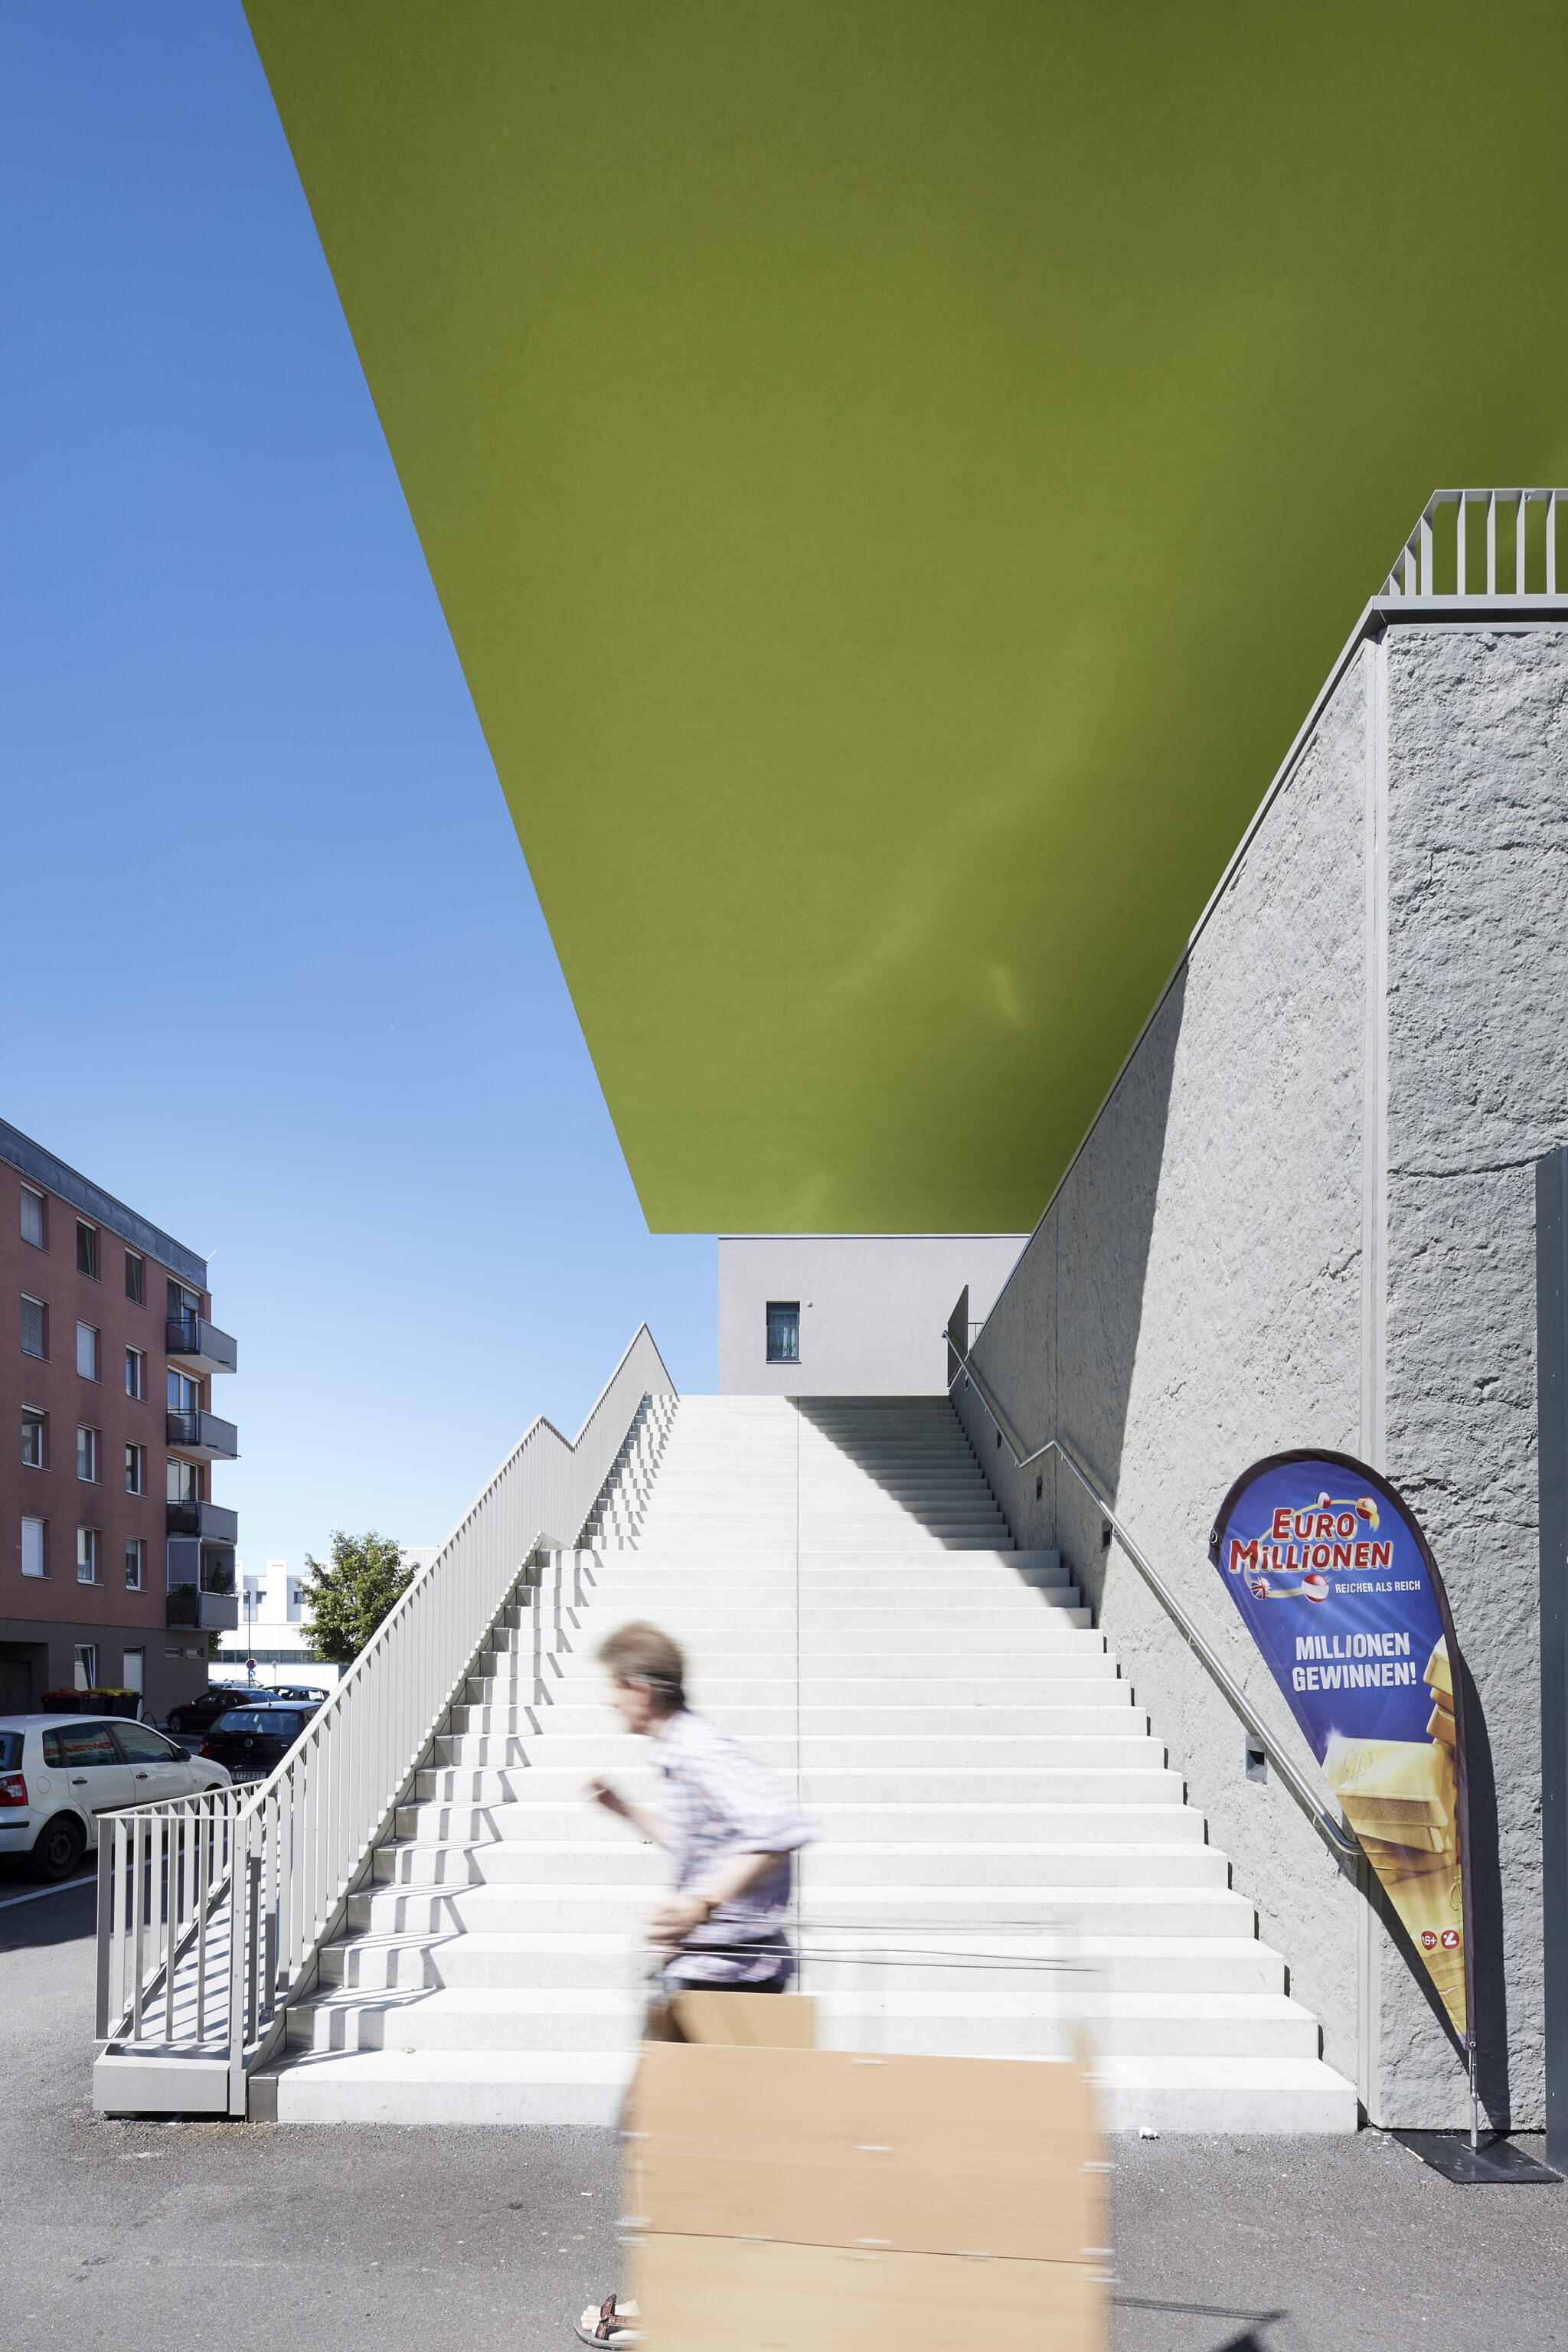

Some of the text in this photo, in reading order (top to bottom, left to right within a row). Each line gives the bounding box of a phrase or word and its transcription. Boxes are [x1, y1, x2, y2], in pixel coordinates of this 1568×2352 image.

[1272, 1508, 1357, 1541] EURO
[1335, 1580, 1421, 1593] REICHER ALS REICH
[1295, 1632, 1410, 1661] MILLIONEN
[1292, 1661, 1417, 1692] GEWINNEN!
[1422, 1936, 1437, 1945] 16+
